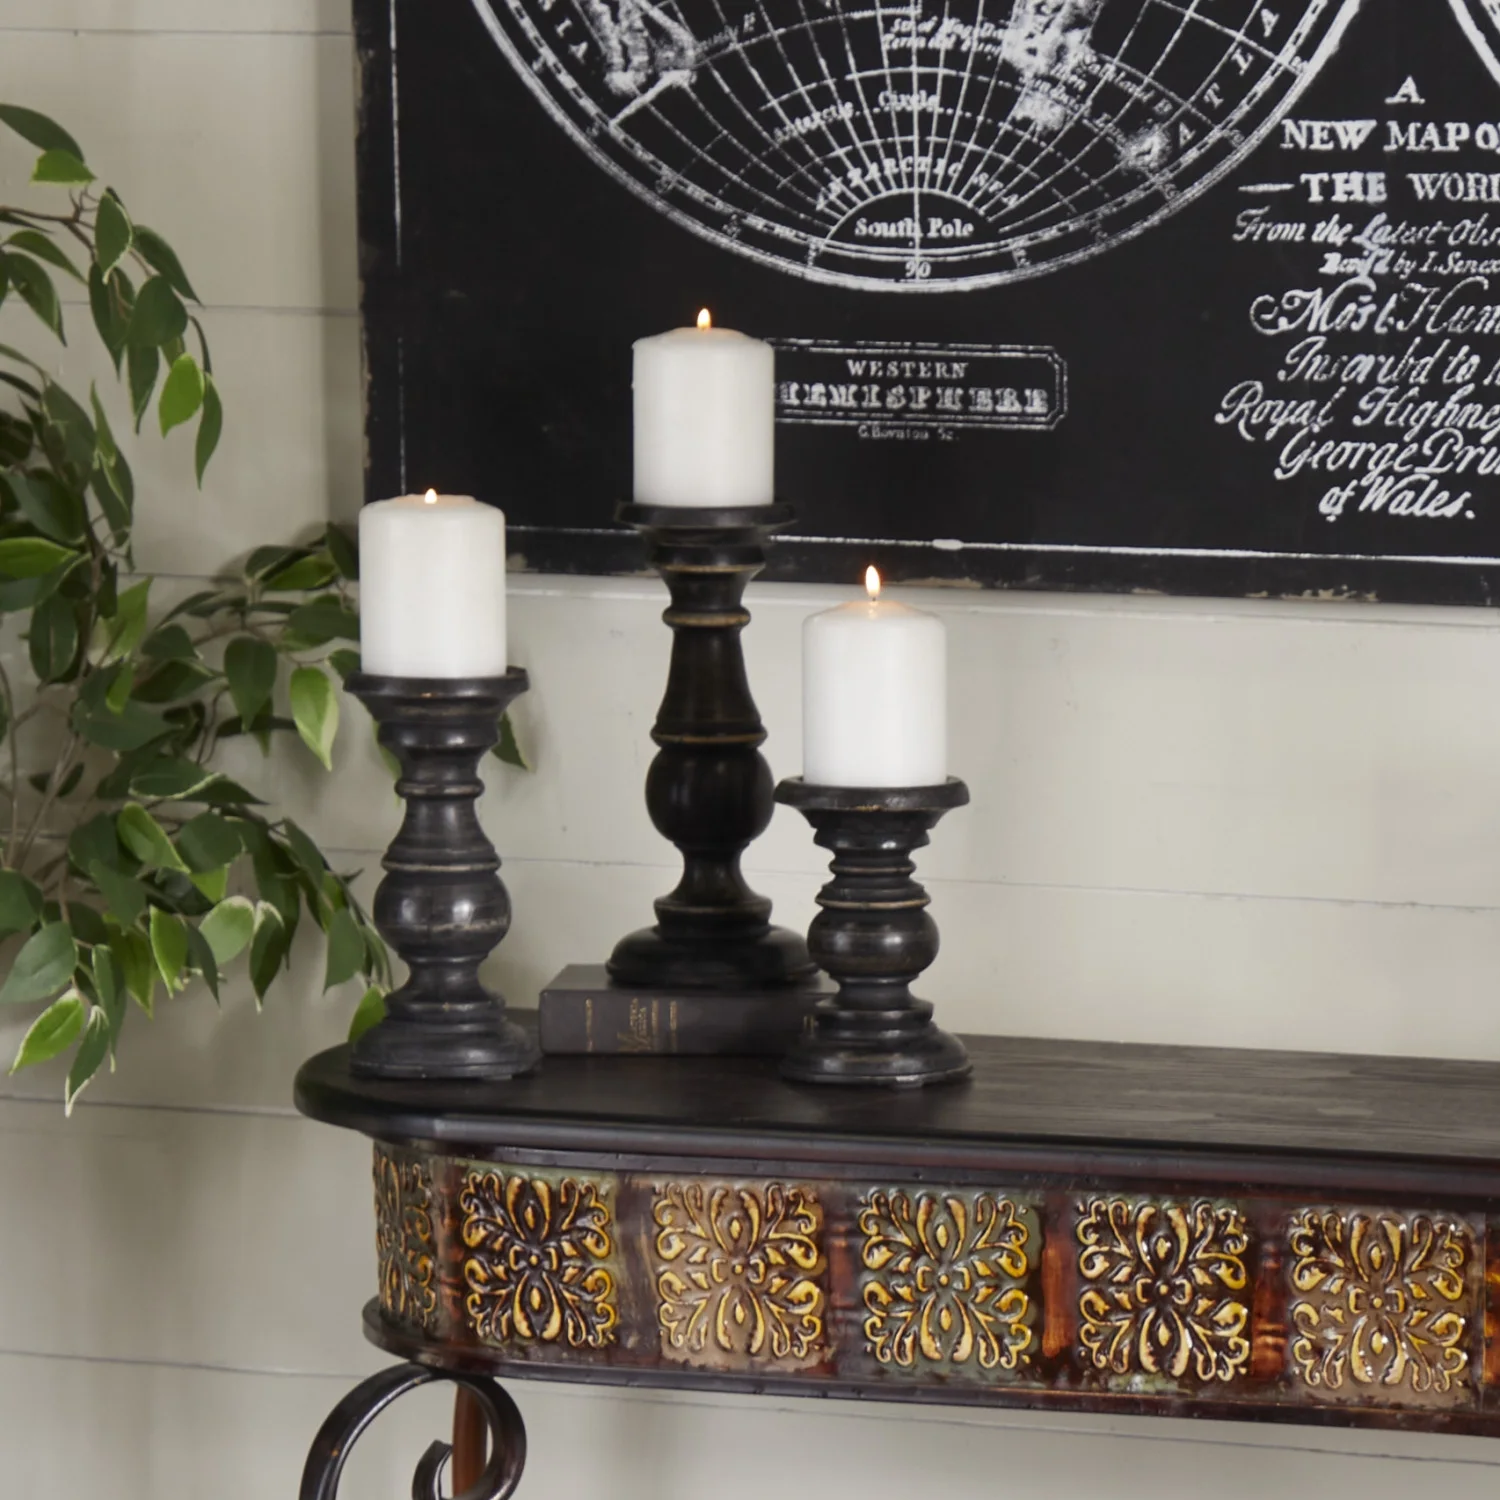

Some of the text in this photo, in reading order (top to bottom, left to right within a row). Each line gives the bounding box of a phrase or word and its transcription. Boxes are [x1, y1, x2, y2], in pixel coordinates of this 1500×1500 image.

[1280, 119, 1378, 151] NEW
[1383, 121, 1473, 153] MAP
[1301, 171, 1388, 203] THE
[854, 216, 975, 239] South Pole
[1232, 206, 1306, 242] From
[1311, 213, 1354, 247] the
[846, 359, 969, 378] WESTERN
[1443, 346, 1481, 384] to
[1215, 381, 1347, 442] Royal
[1274, 426, 1416, 486] George
[1319, 473, 1476, 522] of Wales.
